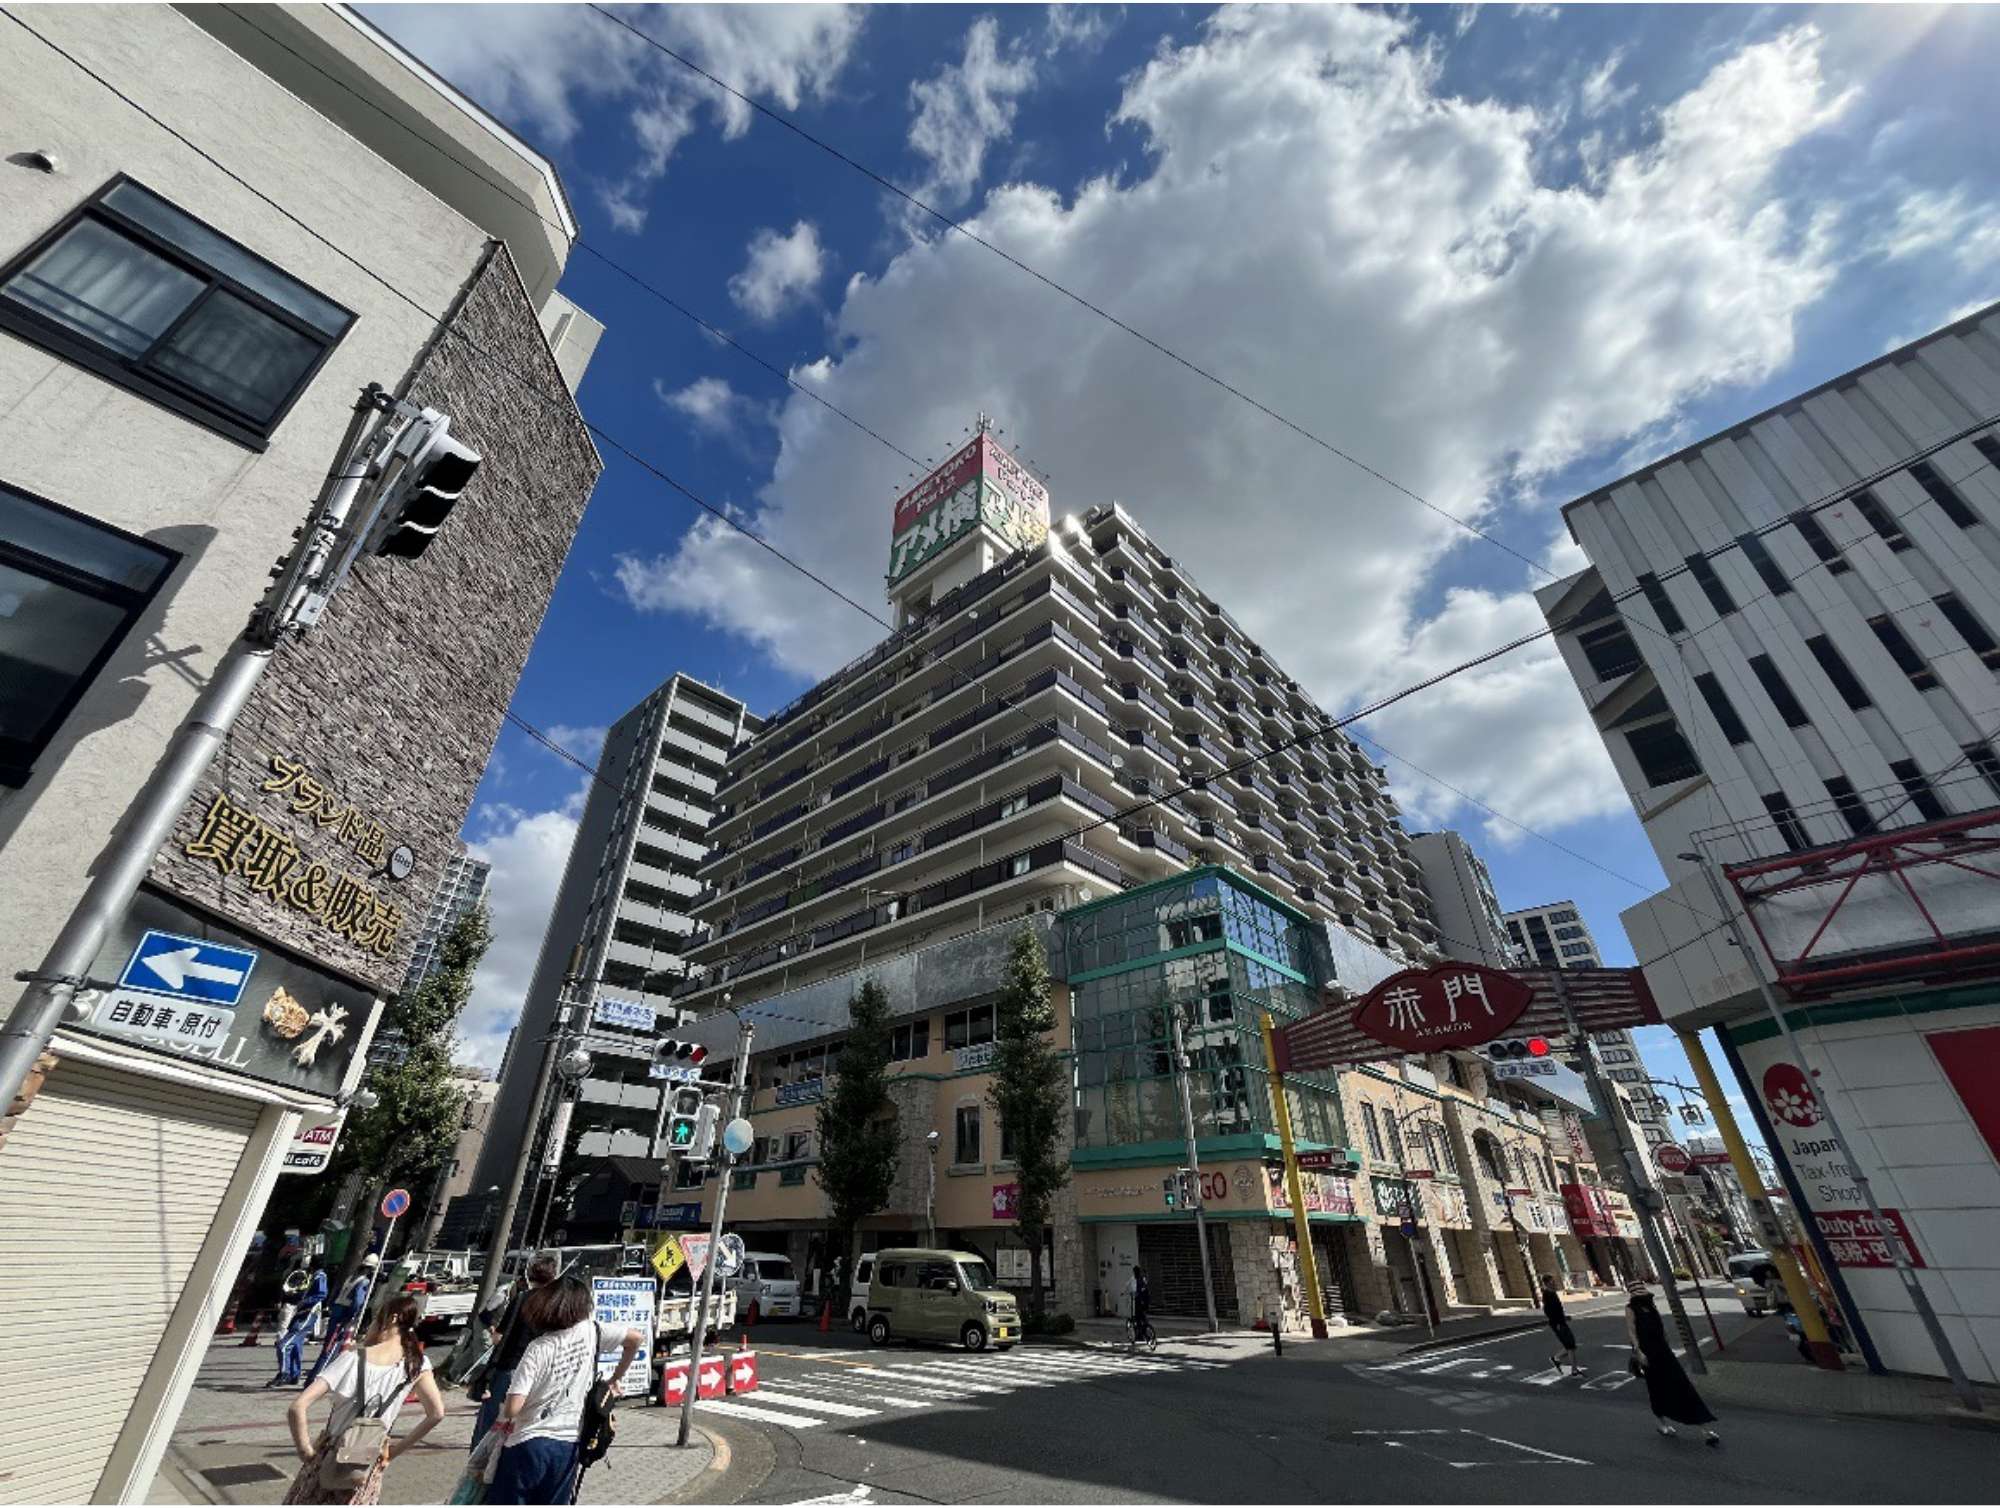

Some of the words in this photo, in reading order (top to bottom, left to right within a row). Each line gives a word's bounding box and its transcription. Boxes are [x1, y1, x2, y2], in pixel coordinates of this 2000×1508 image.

[892, 479, 979, 577] アメ横
[264, 755, 388, 864] ブランド品
[1383, 973, 1496, 1031] 赤門
[1415, 1021, 1473, 1039] AKAMON
[302, 1129, 333, 1142] ATM
[1791, 1138, 1839, 1157] Japan
[1795, 1160, 1851, 1181] Tax-fre
[1818, 1184, 1862, 1205] Shop
[1815, 1214, 1899, 1239] Duty-fre
